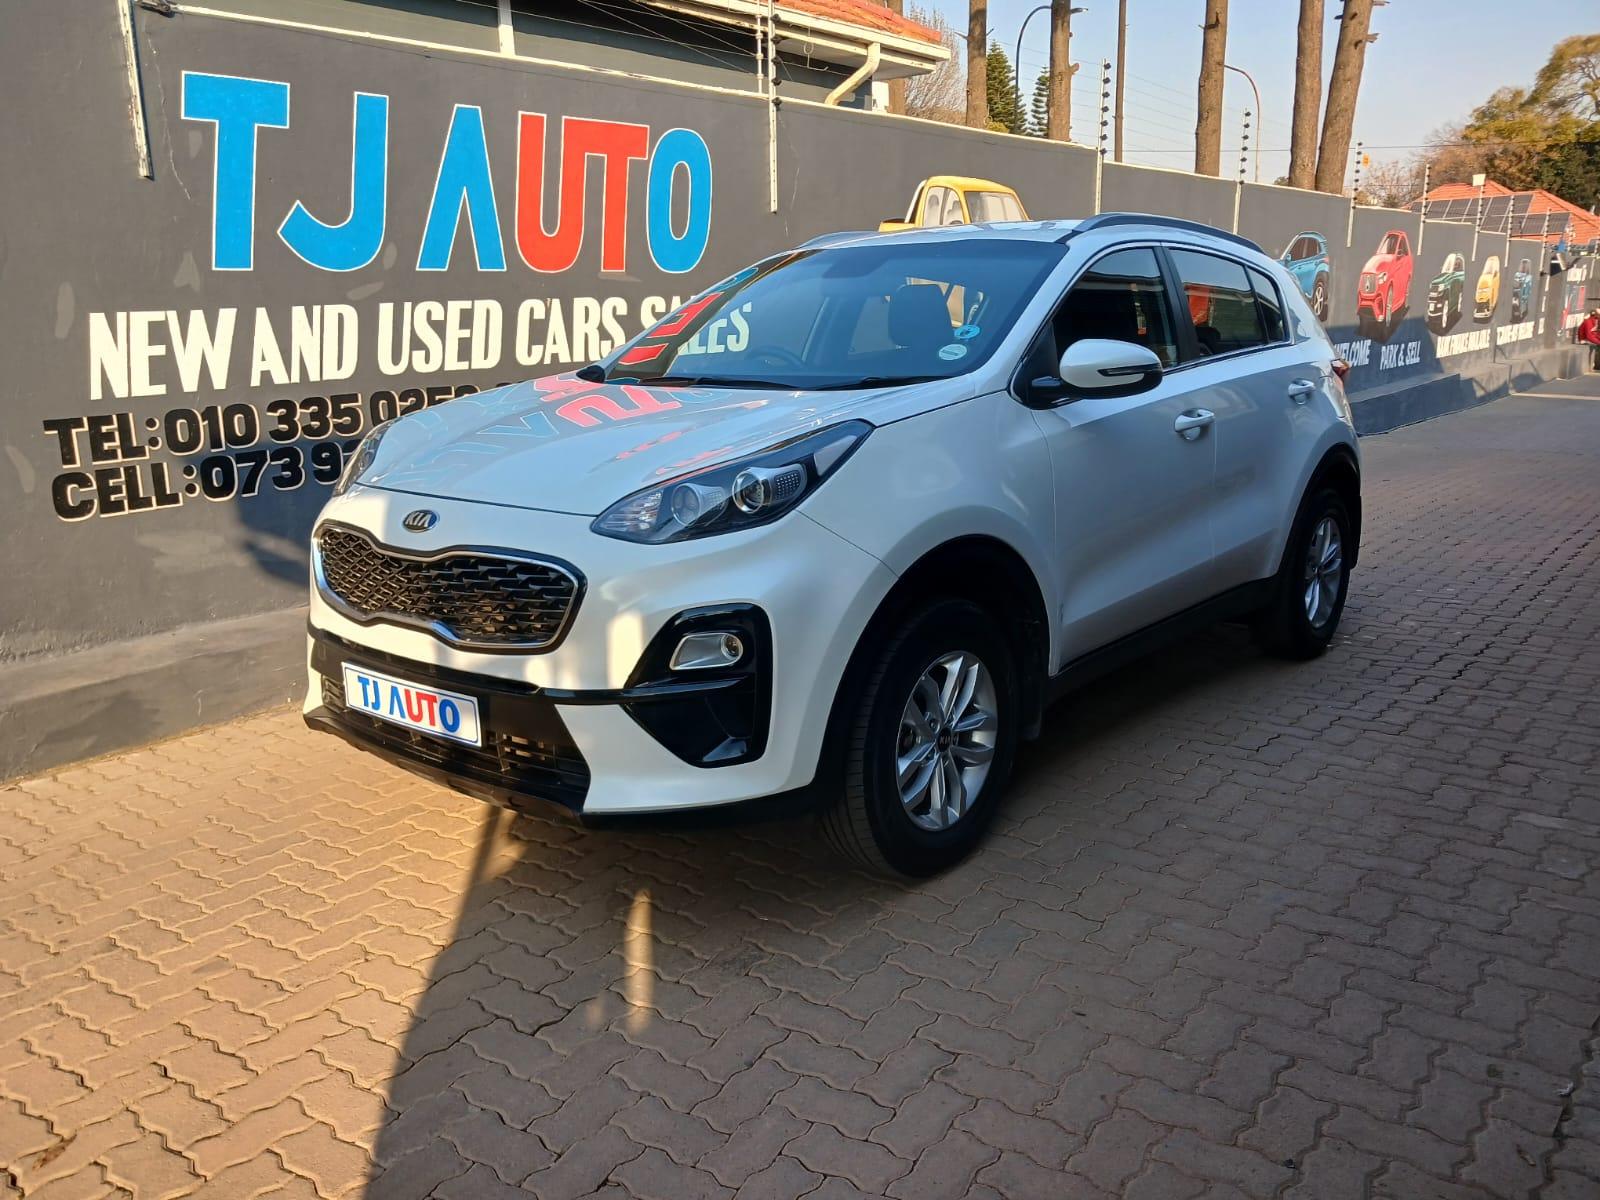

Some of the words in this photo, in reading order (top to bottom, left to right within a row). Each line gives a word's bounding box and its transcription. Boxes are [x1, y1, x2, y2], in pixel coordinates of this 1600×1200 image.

[180, 69, 389, 272] TJ
[416, 103, 713, 275] AUTO
[89, 307, 237, 399] NEW
[250, 303, 358, 387] AND
[377, 299, 502, 376] USED
[514, 296, 628, 366] CARS
[1380, 344, 1399, 370] PARK
[1405, 341, 1421, 365] SELL
[265, 393, 364, 444] 335
[404, 510, 434, 529] KIA
[357, 676, 381, 711] TJ
[389, 686, 460, 733] AUTO
